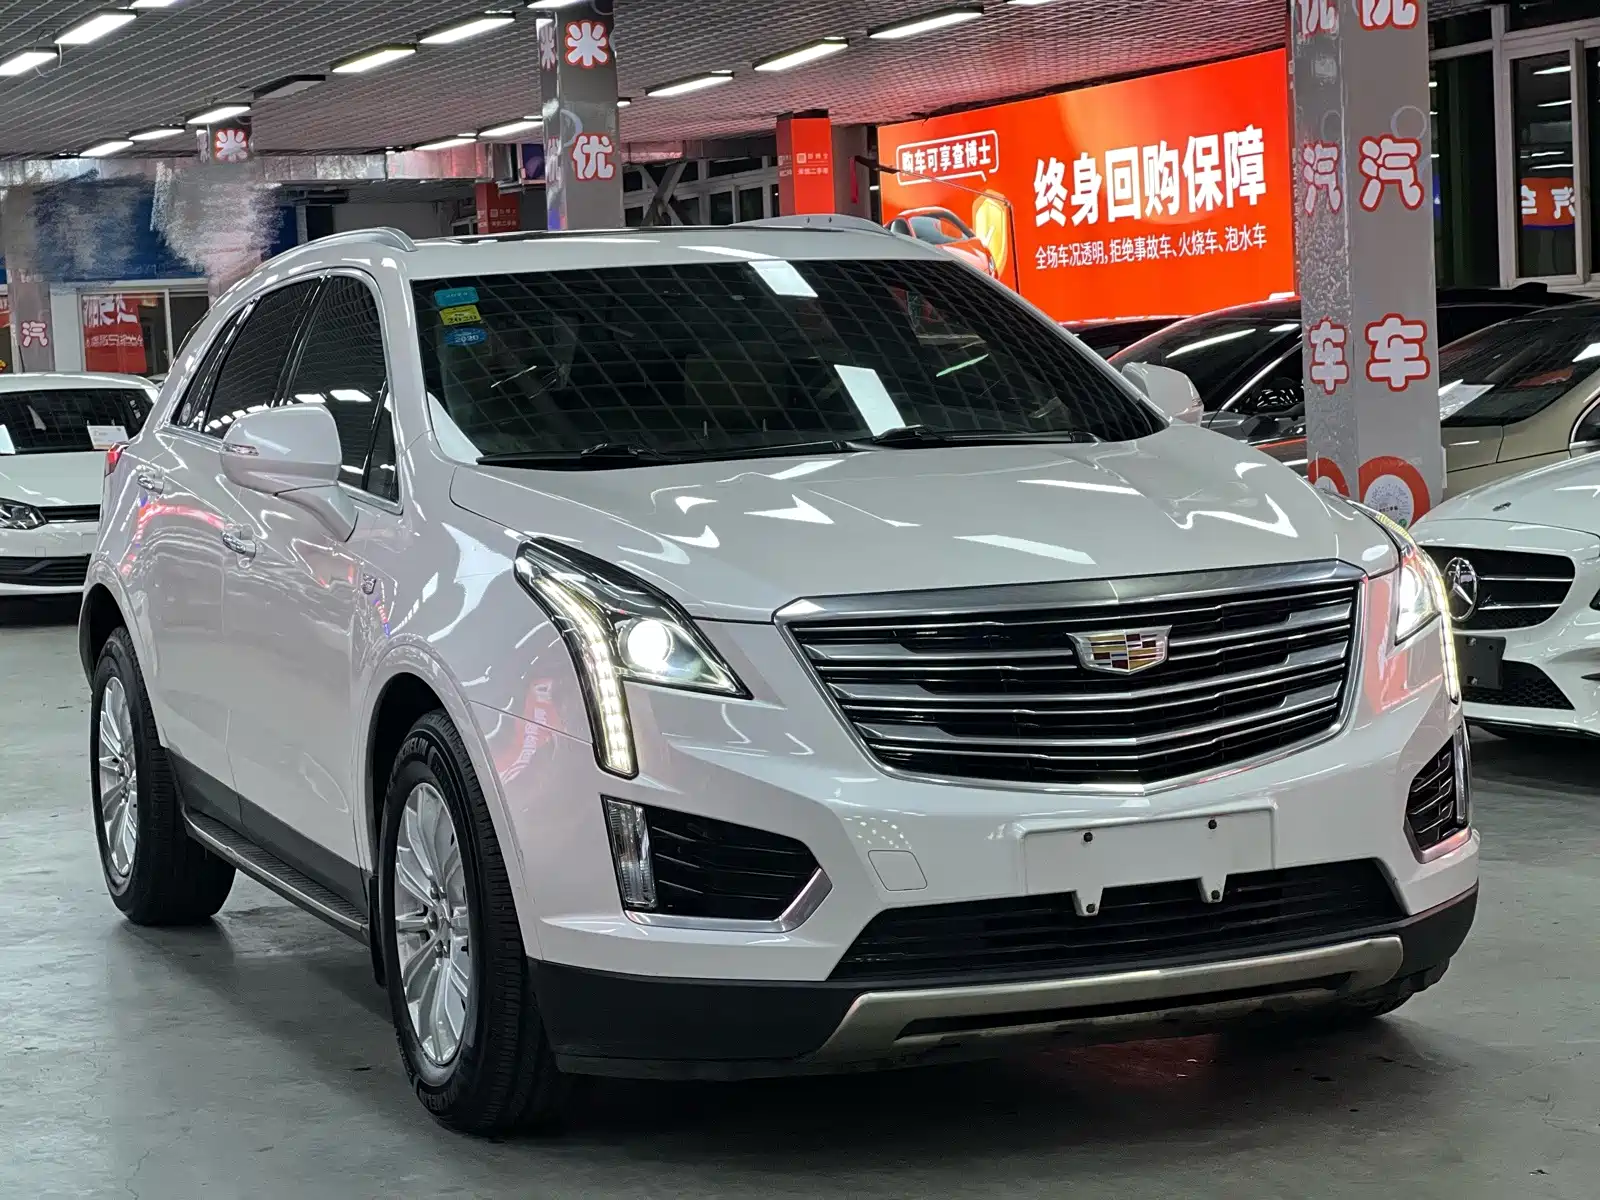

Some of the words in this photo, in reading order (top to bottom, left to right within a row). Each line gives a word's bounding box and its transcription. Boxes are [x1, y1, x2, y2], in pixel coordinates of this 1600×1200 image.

[566, 21, 608, 67] 米
[572, 133, 615, 182] 优
[902, 138, 991, 174] 购车可享查博士
[1034, 124, 1266, 227] 终身回购保障
[1302, 142, 1341, 214] 汽
[1360, 135, 1423, 211] 汽
[21, 320, 48, 347] 汽
[1310, 318, 1348, 393] 车
[1366, 315, 1429, 390] 车
